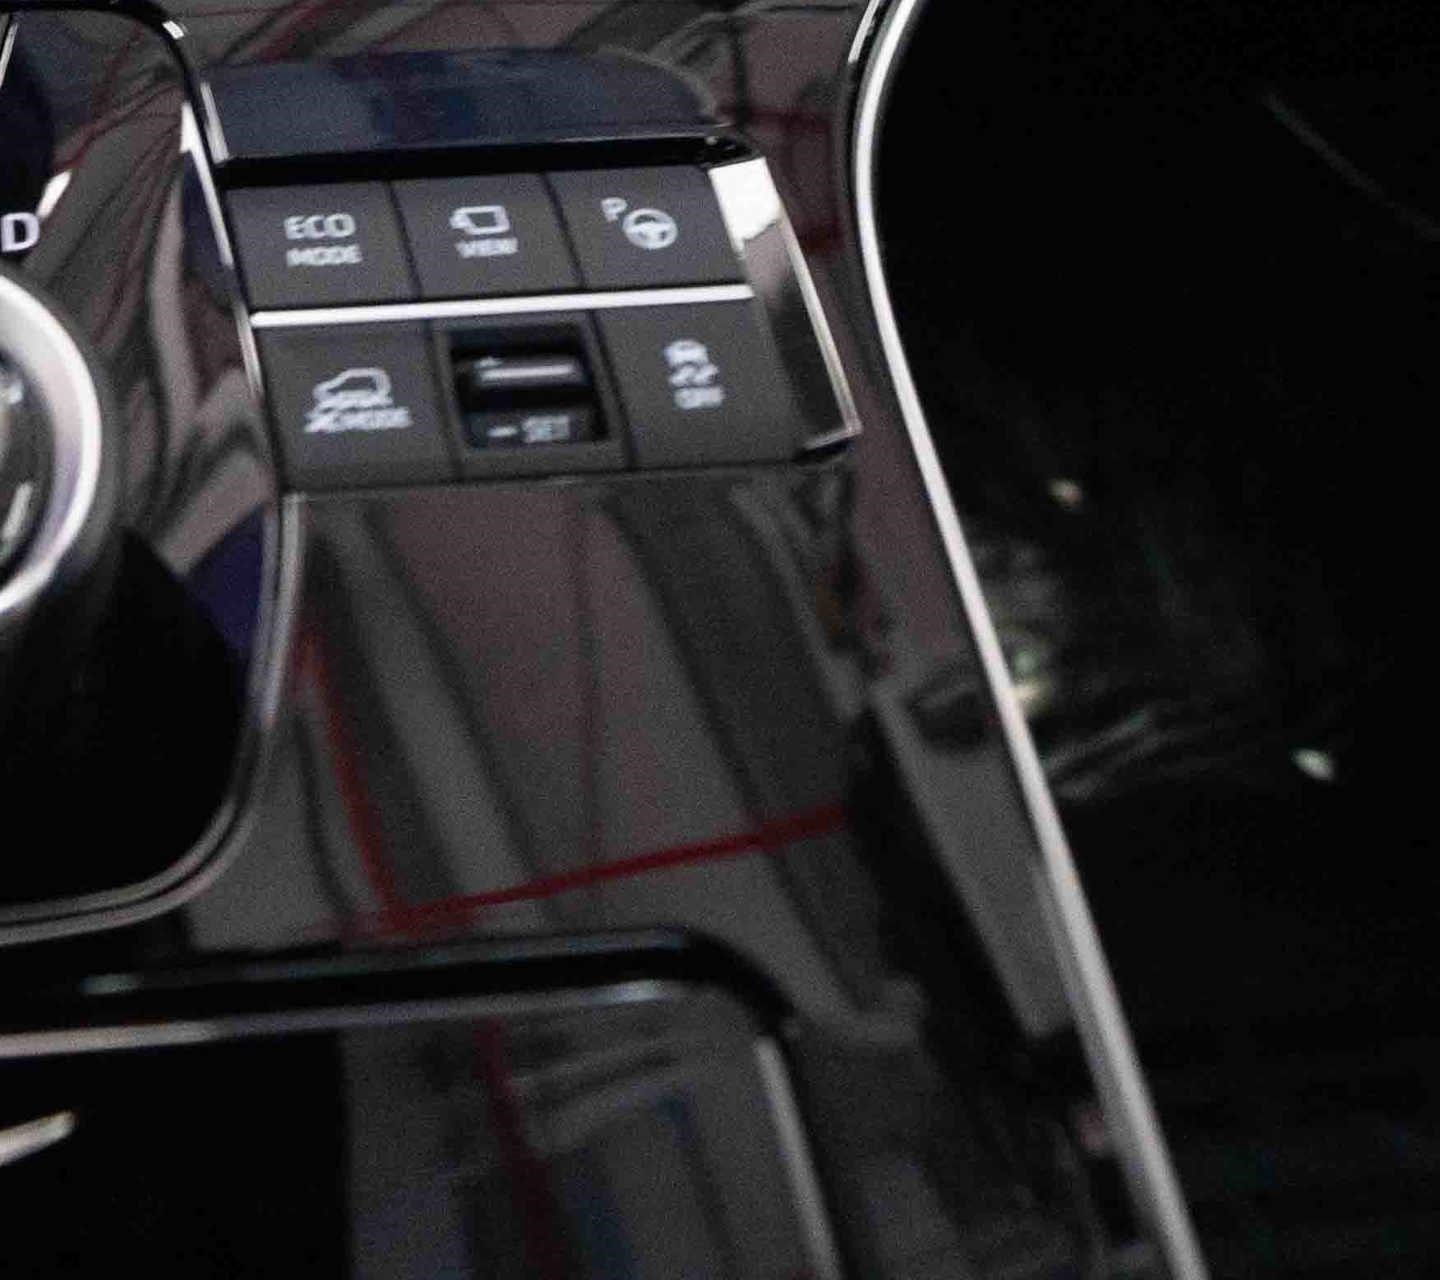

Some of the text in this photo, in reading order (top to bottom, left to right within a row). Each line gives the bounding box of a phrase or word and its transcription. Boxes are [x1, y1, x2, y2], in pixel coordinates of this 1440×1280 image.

[0, 211, 41, 253] D
[284, 213, 356, 240] ECO
[286, 244, 362, 266] MODE
